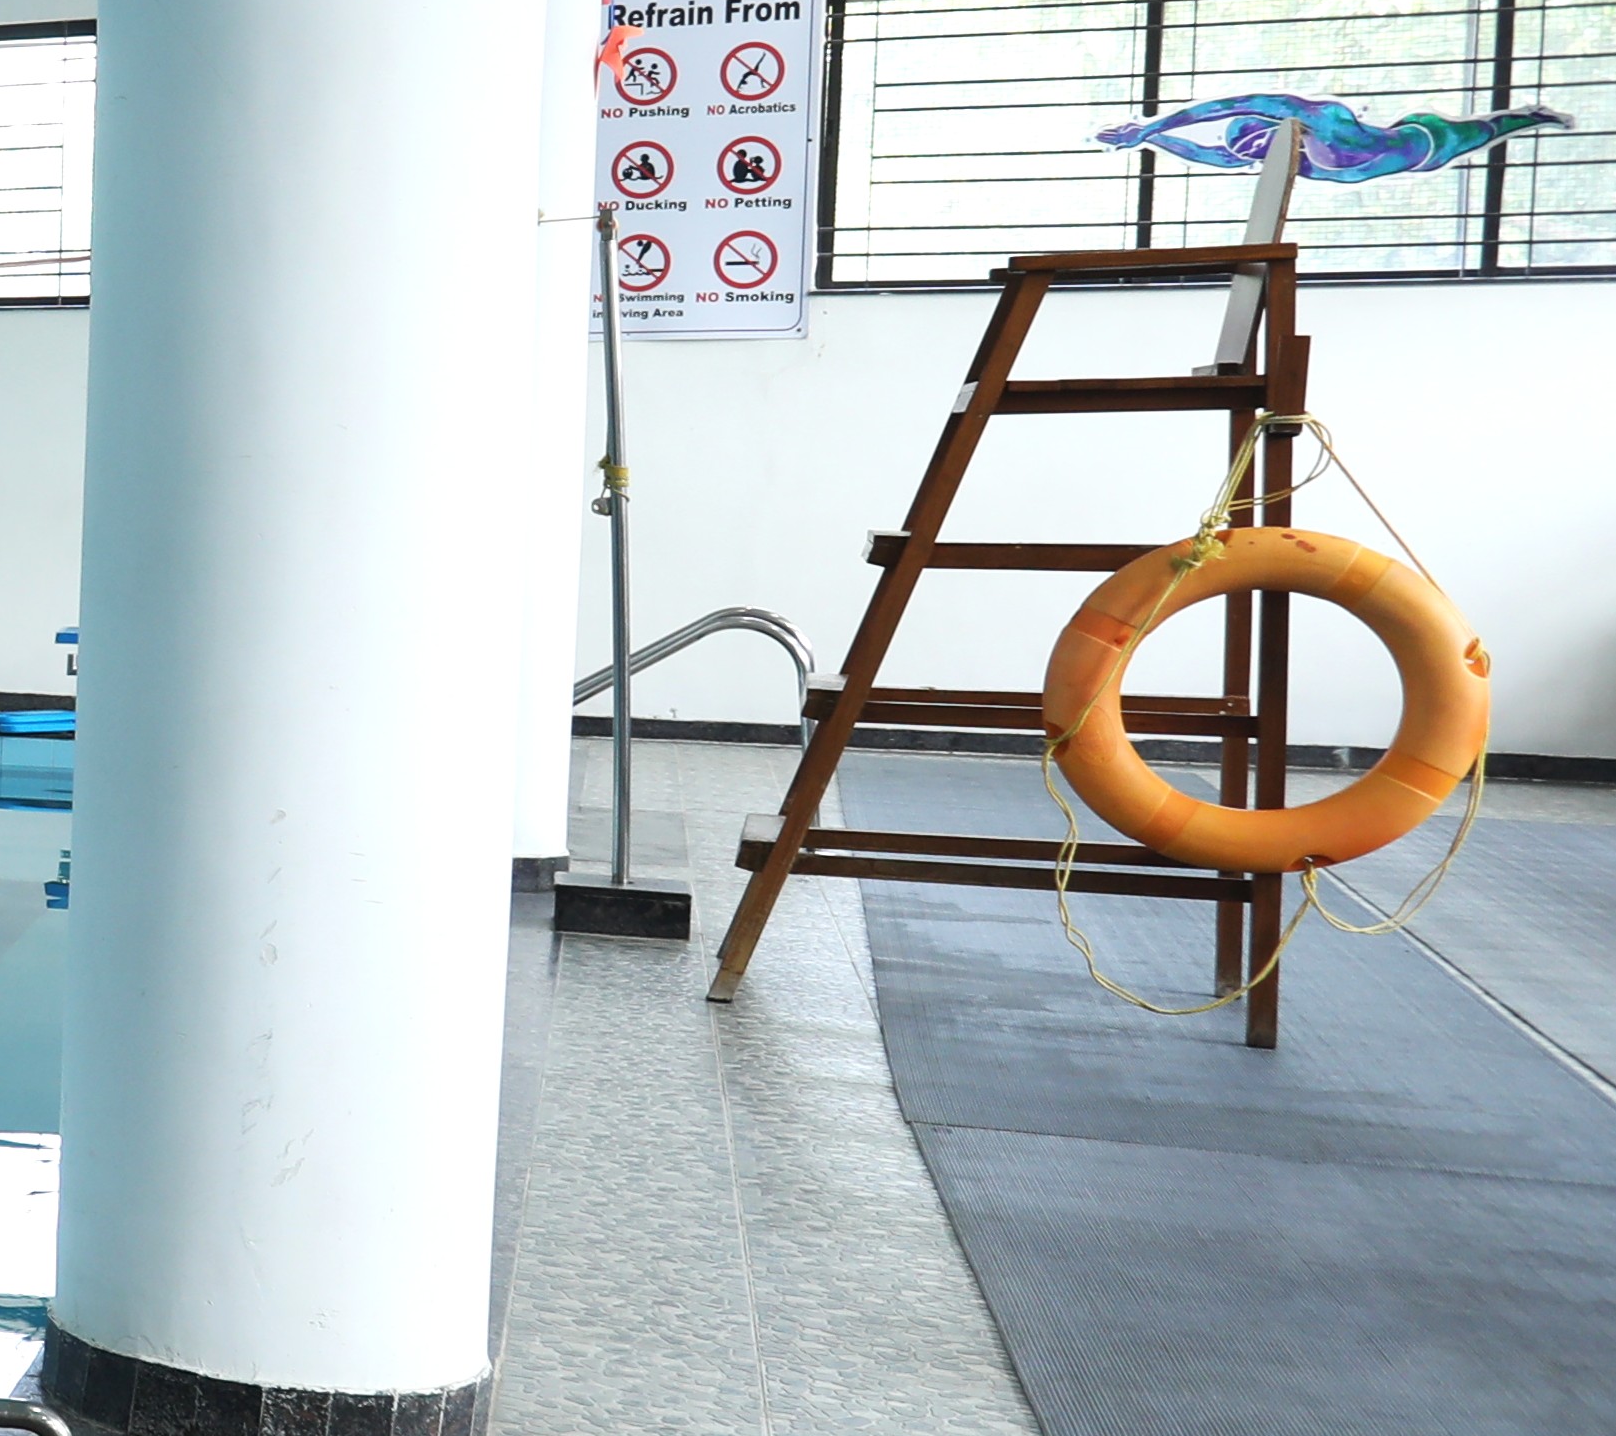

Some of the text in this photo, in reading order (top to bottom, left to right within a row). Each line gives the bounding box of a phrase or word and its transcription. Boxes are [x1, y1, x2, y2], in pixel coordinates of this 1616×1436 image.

[608, 2, 713, 29] Refrain
[601, 105, 690, 119] NO Pushing
[707, 102, 796, 116] NO Acrobatics
[598, 200, 687, 212] NO Ducking
[705, 196, 792, 210] NO Petting
[620, 293, 685, 303] Swimming
[696, 290, 794, 304] NO Smoking
[653, 308, 684, 317] Area
